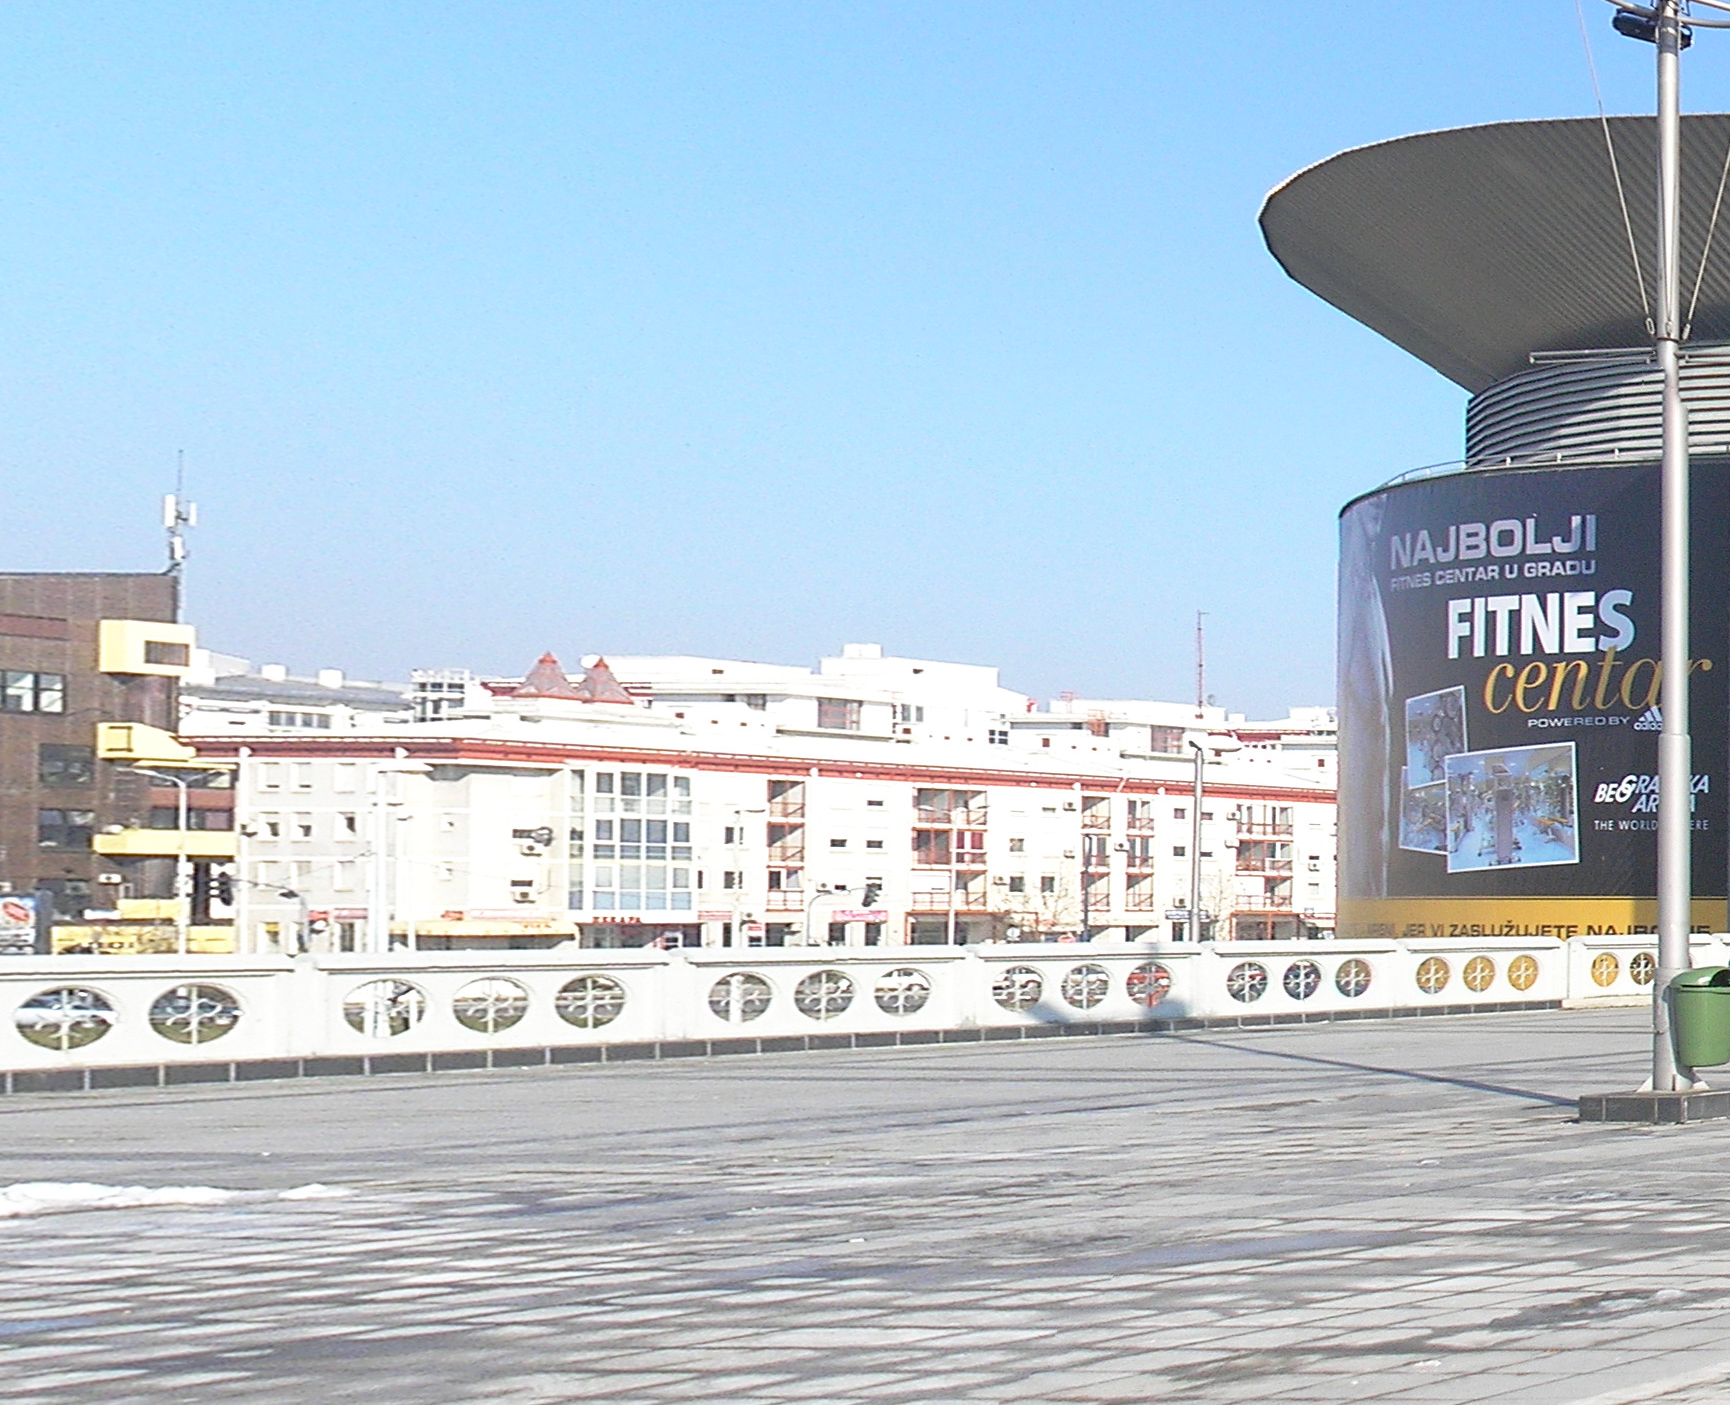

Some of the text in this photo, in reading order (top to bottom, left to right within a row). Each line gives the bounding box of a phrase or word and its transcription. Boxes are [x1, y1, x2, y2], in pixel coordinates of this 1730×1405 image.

[1391, 515, 1596, 570] NAJBOLJI
[1391, 559, 1597, 592] FITNES CENTAR U GRADU
[1448, 589, 1635, 658] FITNES
[1527, 715, 1631, 729] POWERED BY
[1633, 721, 1662, 731] adida
[1594, 775, 1709, 803] BEOGRAKA
[1594, 820, 1710, 831] THE WORLD ERE
[1449, 919, 1579, 938] ZASLUŽUJETE
